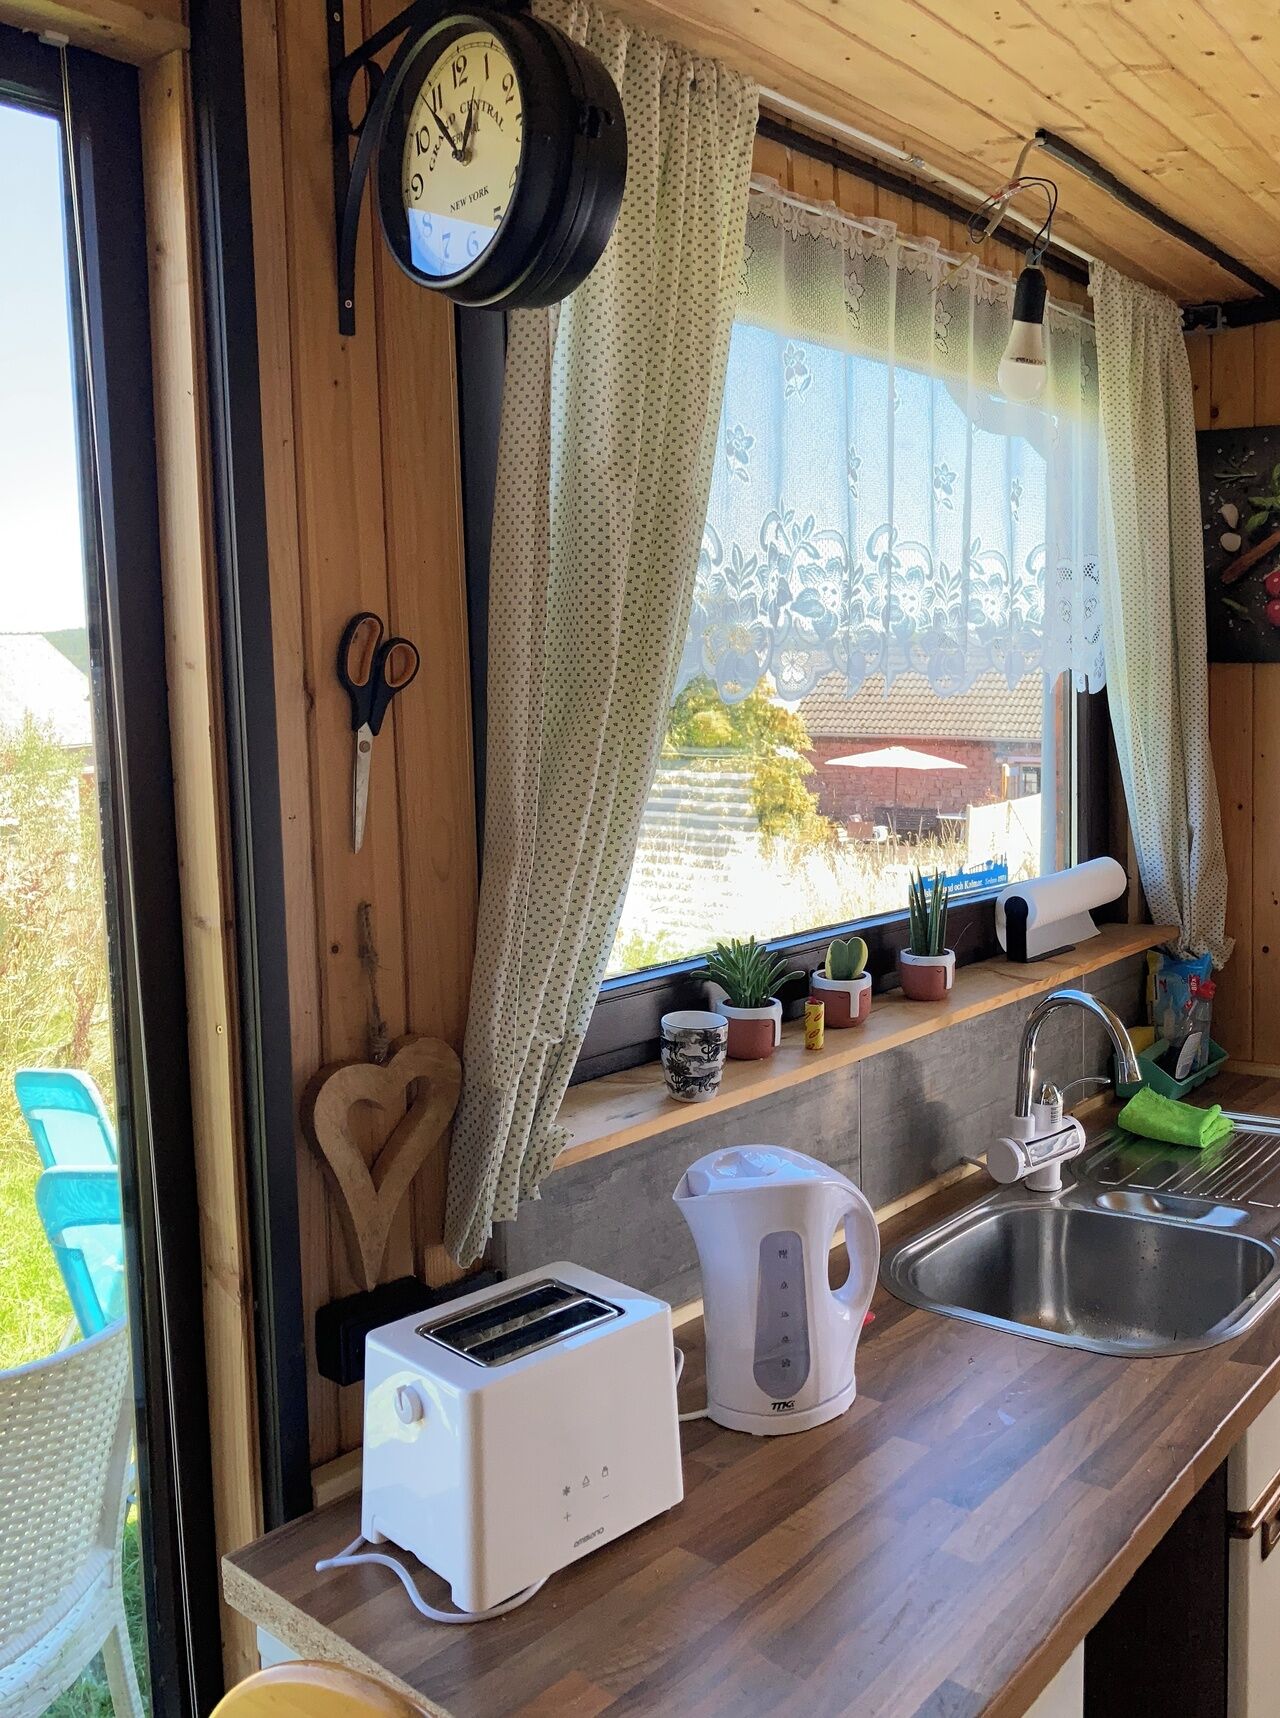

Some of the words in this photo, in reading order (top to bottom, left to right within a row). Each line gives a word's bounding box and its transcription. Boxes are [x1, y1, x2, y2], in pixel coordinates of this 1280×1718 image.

[452, 55, 468, 90] 12
[432, 83, 442, 113] 11
[502, 73, 515, 104] 2
[416, 125, 430, 157] 10
[411, 173, 424, 201] 9
[450, 198, 467, 213] NEW
[468, 186, 489, 204] YORK
[422, 213, 433, 239] 8
[442, 232, 451, 259] 7
[466, 230, 479, 257] 6
